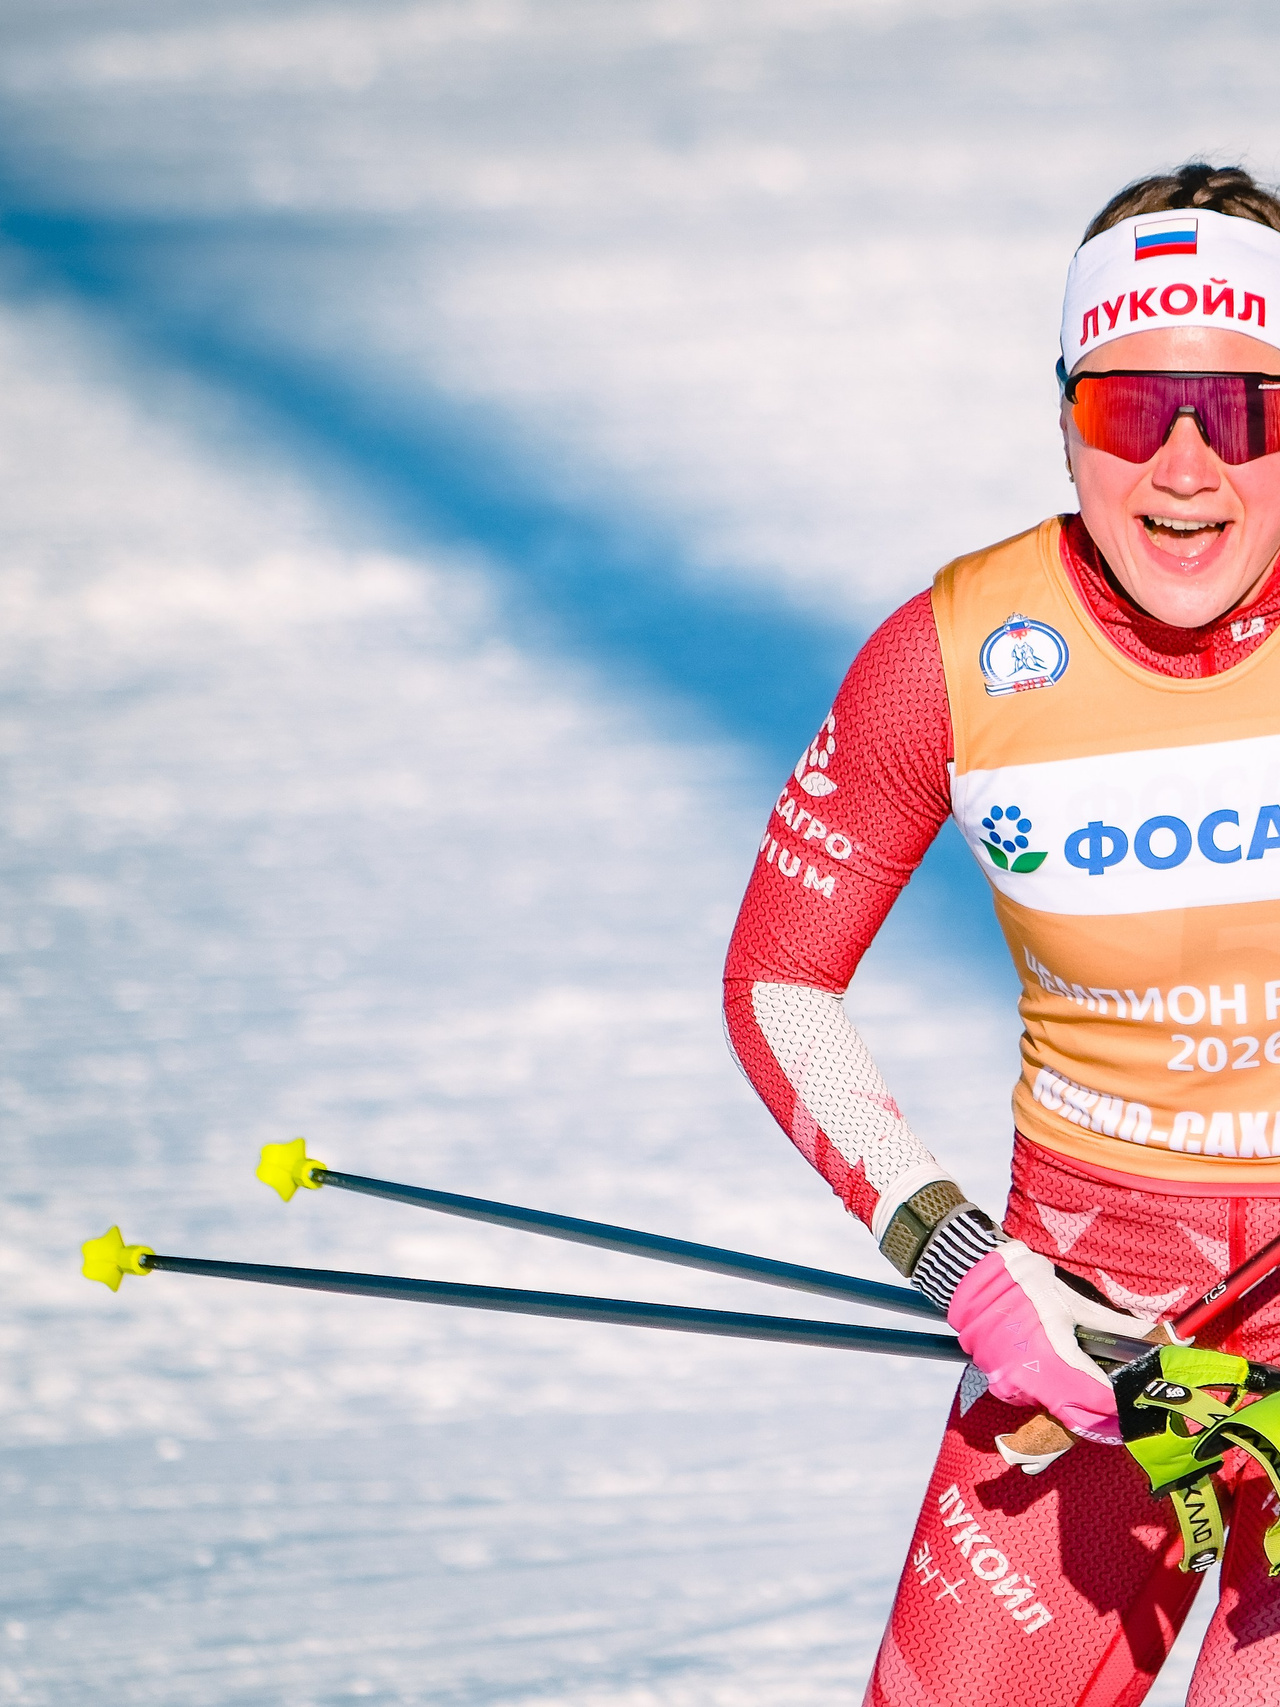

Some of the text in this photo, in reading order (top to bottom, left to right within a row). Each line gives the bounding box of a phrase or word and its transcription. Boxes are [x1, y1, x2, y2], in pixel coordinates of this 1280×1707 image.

[1080, 277, 1266, 347] ЛУКОЙЛ
[774, 786, 853, 861] САГРО
[1022, 944, 1248, 1027] ЧЕМПИОН
[938, 1483, 1054, 1636] ЛУКОЙЛ
